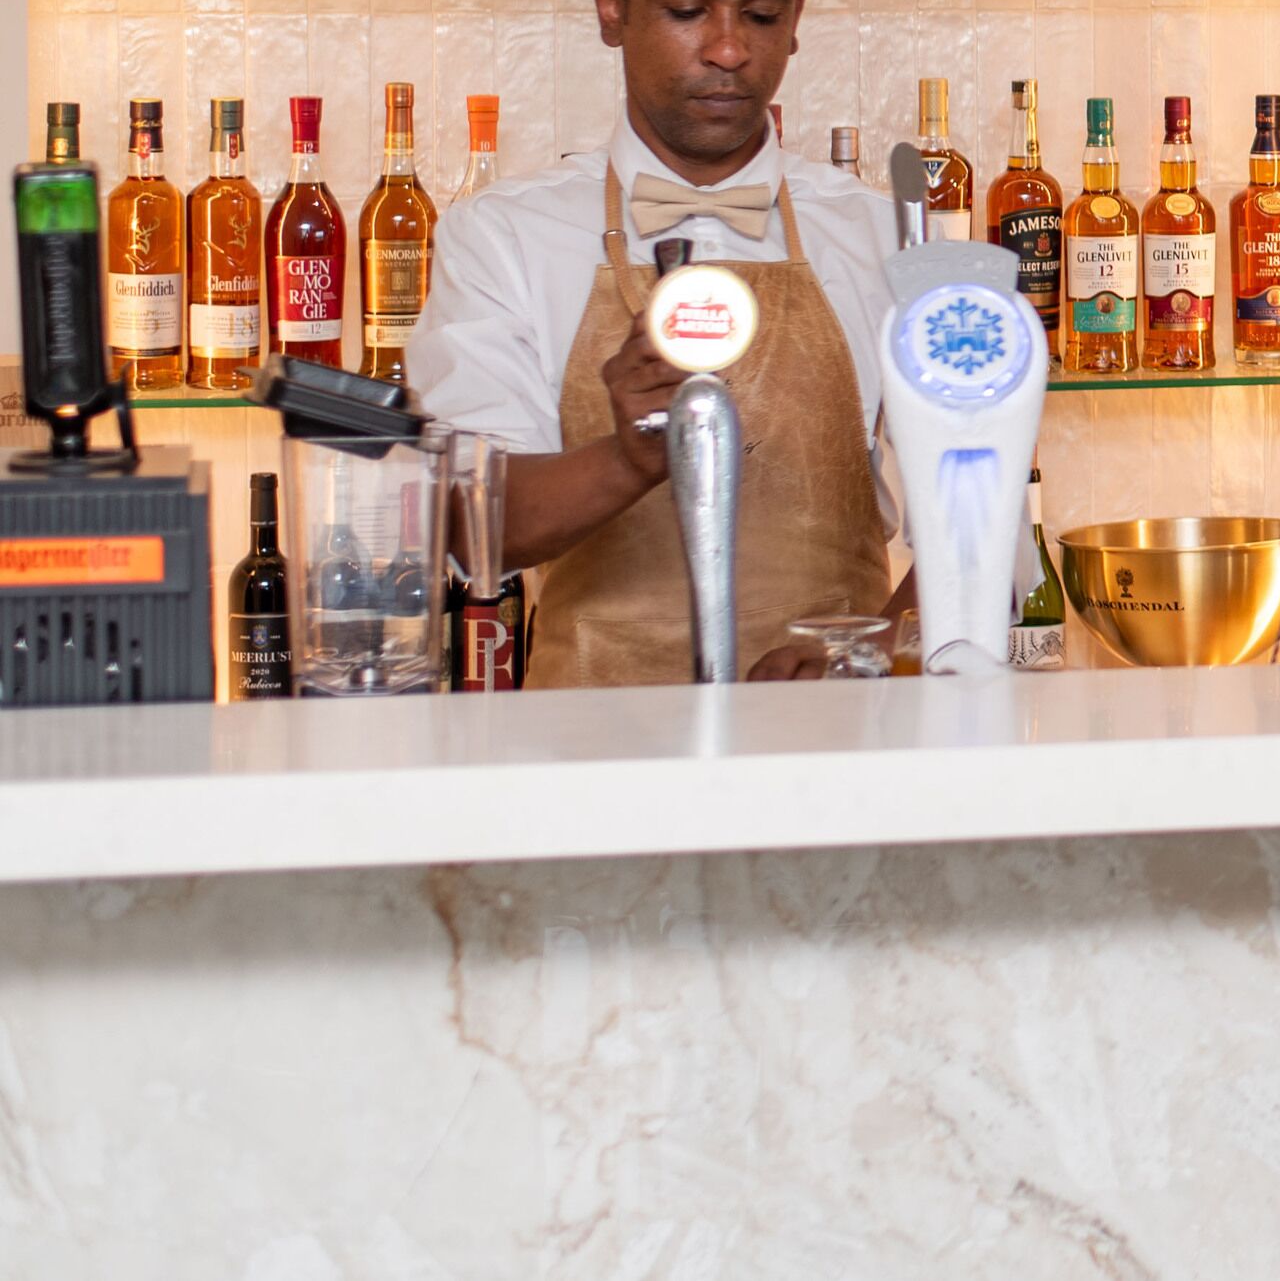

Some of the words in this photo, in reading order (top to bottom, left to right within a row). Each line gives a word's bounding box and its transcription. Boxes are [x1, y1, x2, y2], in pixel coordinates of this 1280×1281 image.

[302, 143, 314, 153] 12
[480, 141, 490, 151] 10
[1009, 215, 1061, 236] JAMESO
[1172, 242, 1190, 250] THE
[1077, 251, 1132, 263] GLENLIVET
[1153, 250, 1209, 261] GLENLIVET
[288, 259, 331, 274] GLEN
[1017, 262, 1041, 272] ELECT
[1041, 260, 1061, 271] RESER
[1268, 257, 1280, 267] 18
[1099, 265, 1114, 277] 12
[1175, 263, 1189, 275] 15
[115, 279, 174, 297] Glenfiddich
[303, 275, 332, 290] MO
[289, 290, 322, 304] RAN
[303, 303, 327, 318] GIE
[310, 323, 322, 335] 12
[1087, 598, 1185, 611] BOSCHENDAL
[231, 650, 292, 664] MEERLUST
[239, 677, 282, 689] Rubicon
